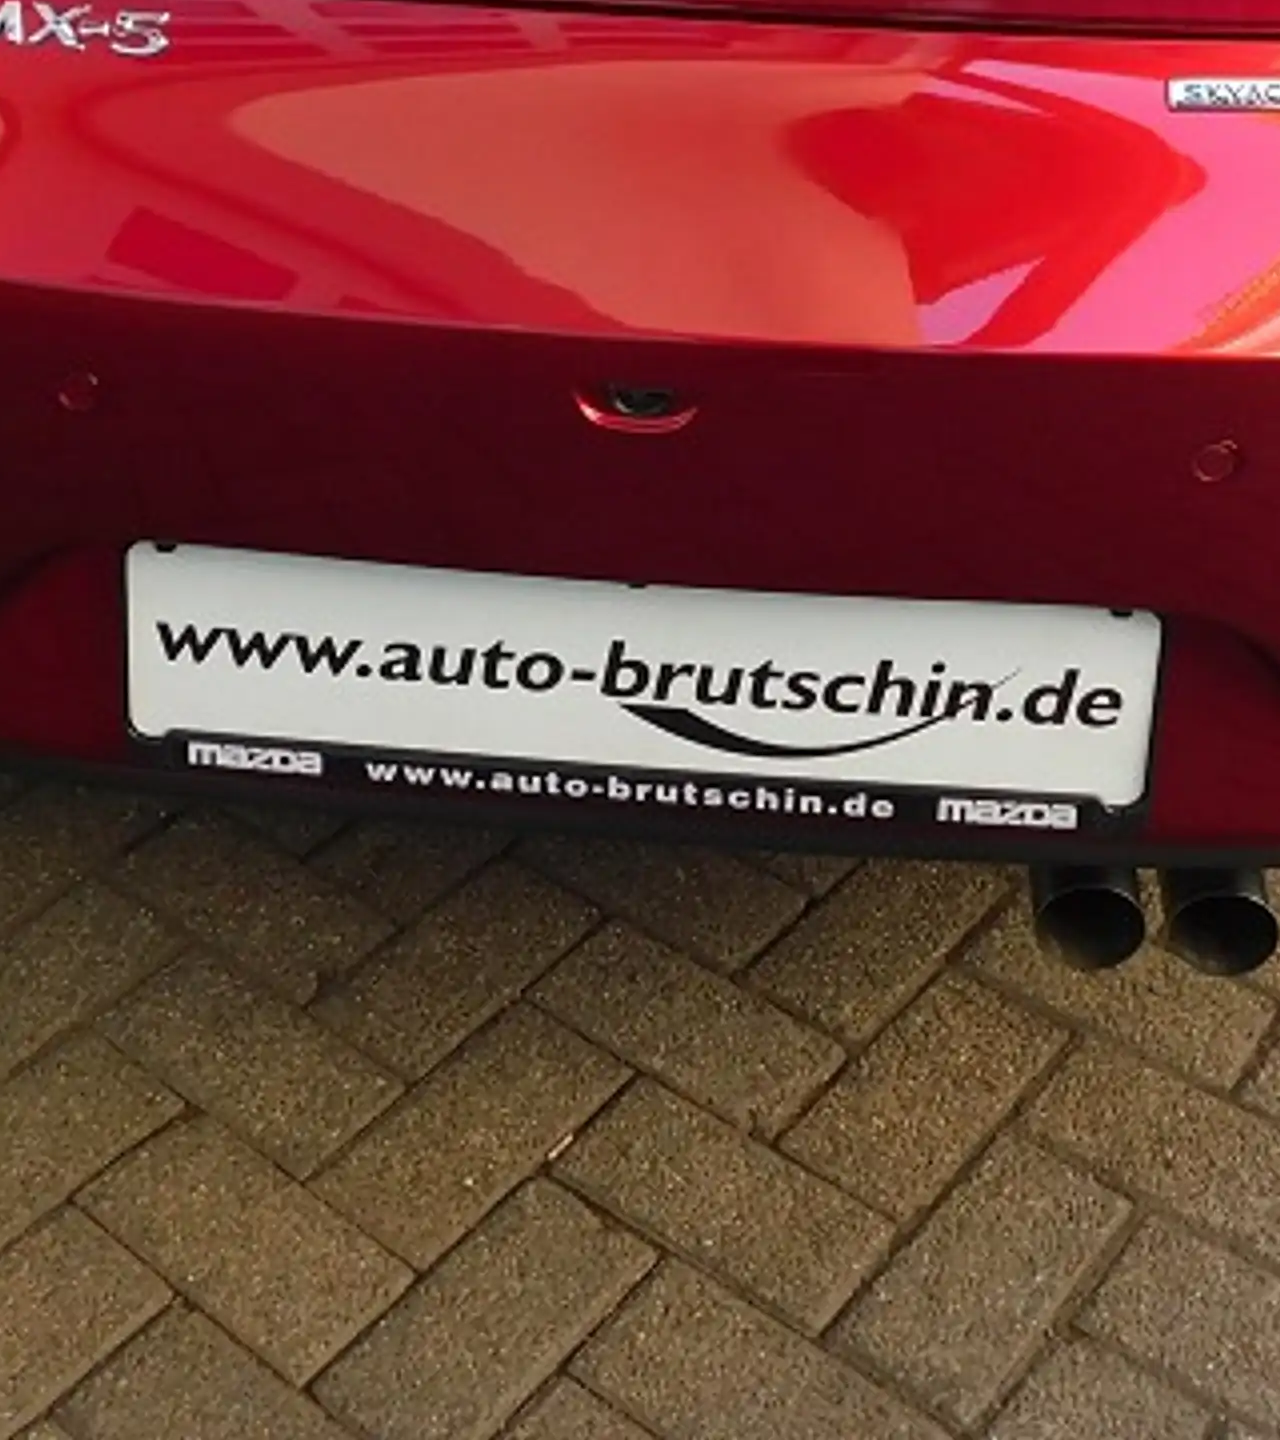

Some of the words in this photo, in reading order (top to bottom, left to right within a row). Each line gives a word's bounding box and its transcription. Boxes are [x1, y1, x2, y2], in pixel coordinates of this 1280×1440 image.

[156, 621, 1124, 727] www.auto-brutschin.de
[187, 741, 322, 776] mazda
[365, 762, 895, 818] www.auto-brutschin.de
[936, 797, 1078, 829] mazda
